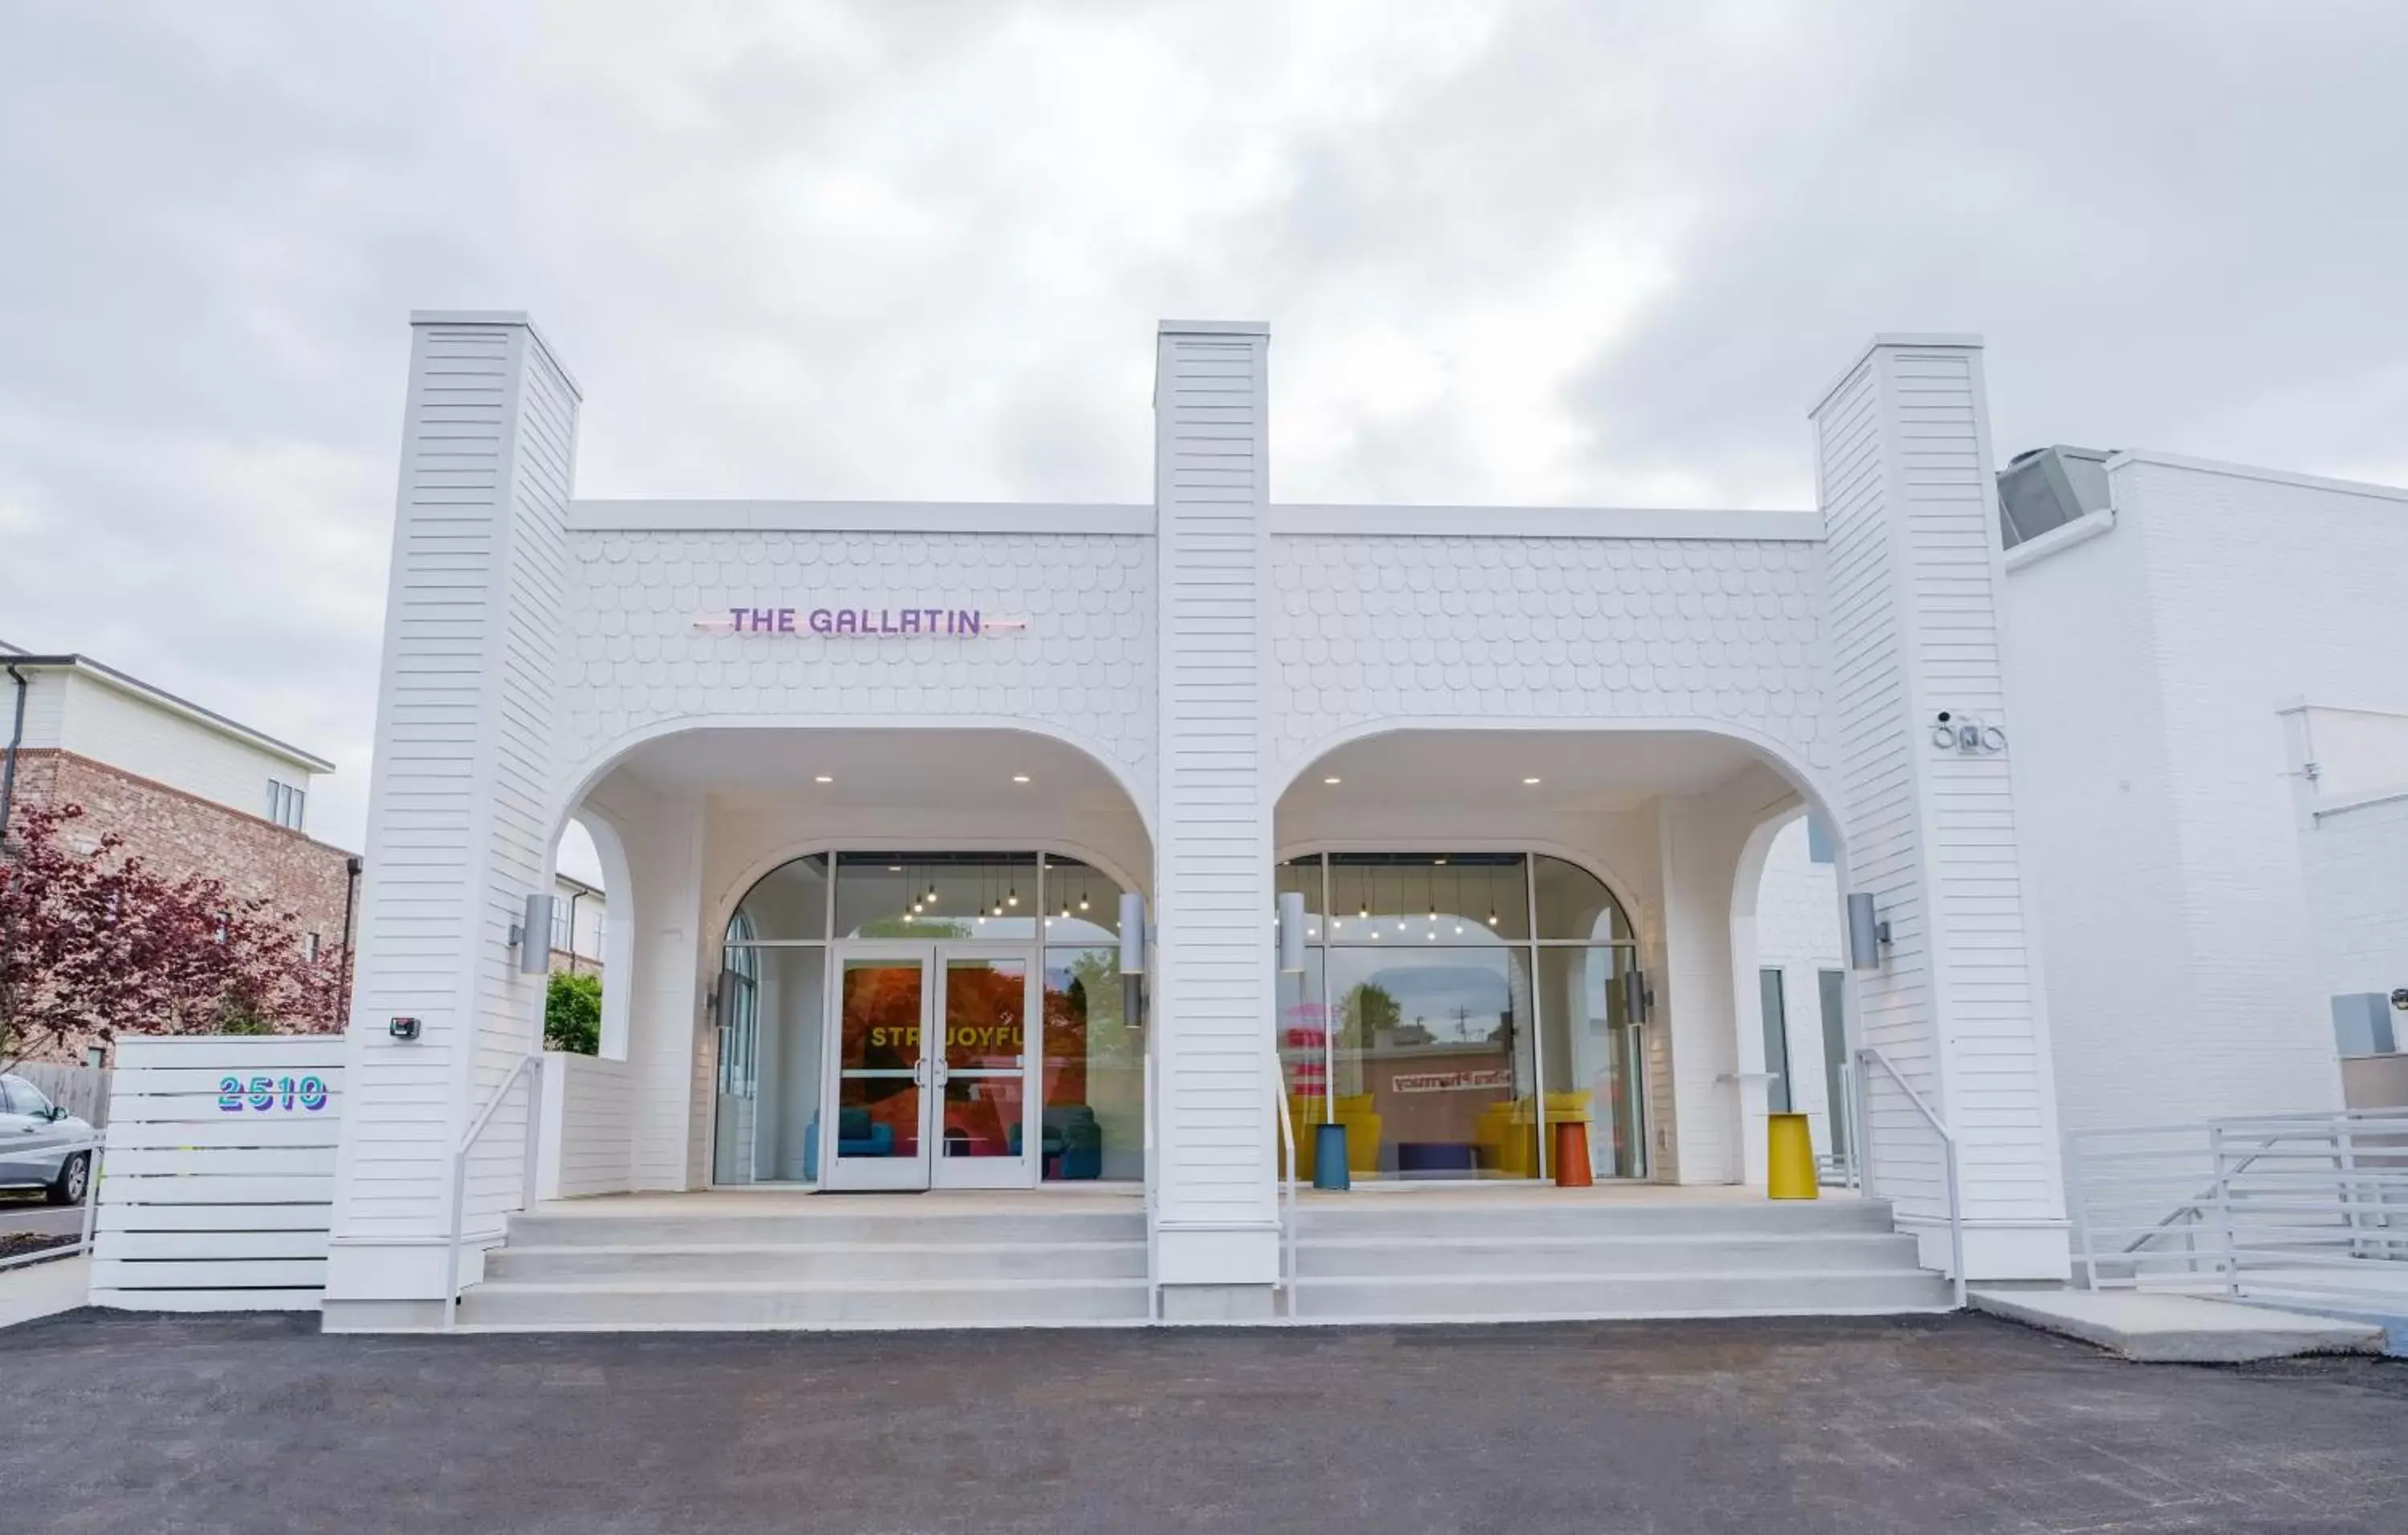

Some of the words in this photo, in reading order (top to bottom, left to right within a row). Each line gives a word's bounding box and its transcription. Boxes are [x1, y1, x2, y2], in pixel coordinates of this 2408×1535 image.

[730, 608, 795, 632] THE
[809, 609, 980, 635] GALLATIN
[946, 1027, 1023, 1047] JOYFU
[218, 1077, 327, 1111] 2510
